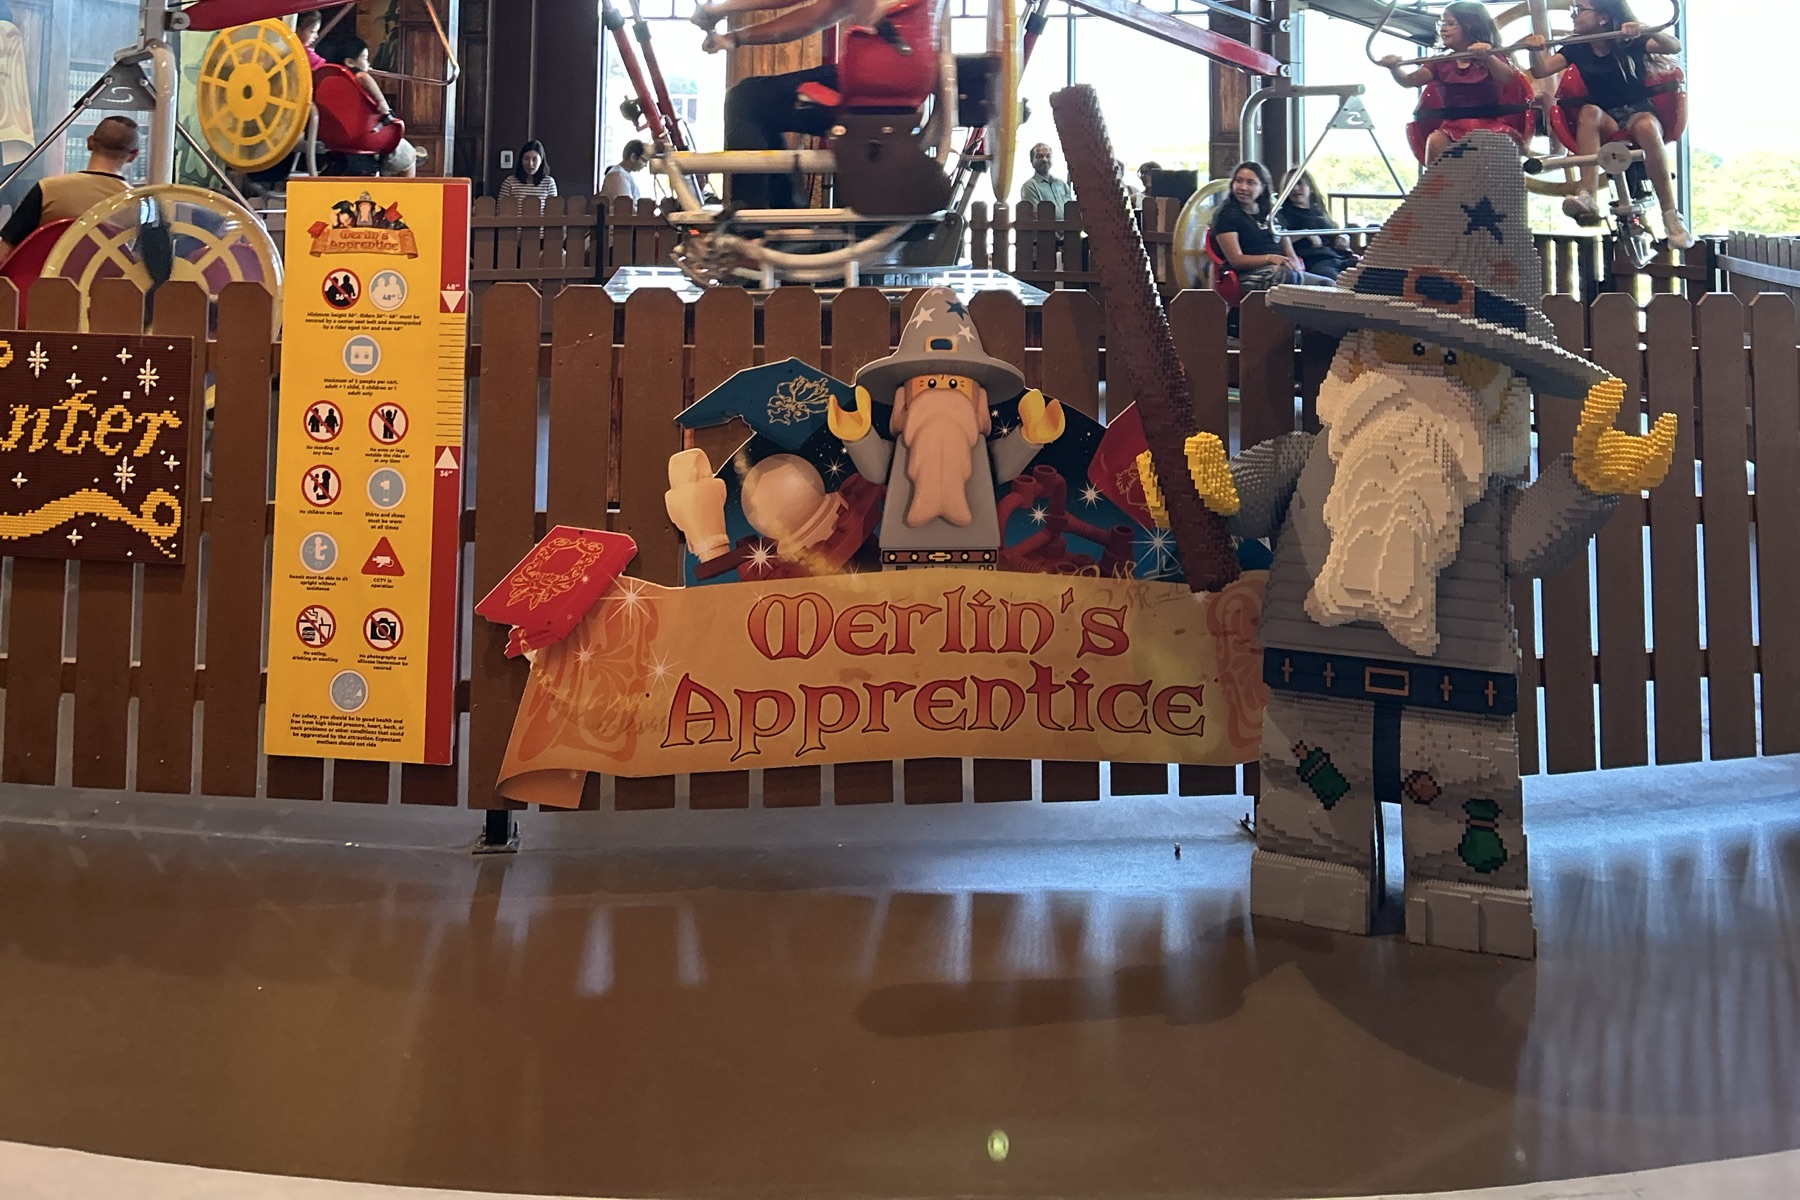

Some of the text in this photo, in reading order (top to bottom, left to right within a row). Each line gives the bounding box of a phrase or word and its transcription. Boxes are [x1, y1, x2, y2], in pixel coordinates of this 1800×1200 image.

[329, 240, 399, 250] Apprentice
[340, 230, 389, 240] Merlin's
[747, 585, 1130, 661] Merlin's
[660, 659, 1206, 762] Apprentice
